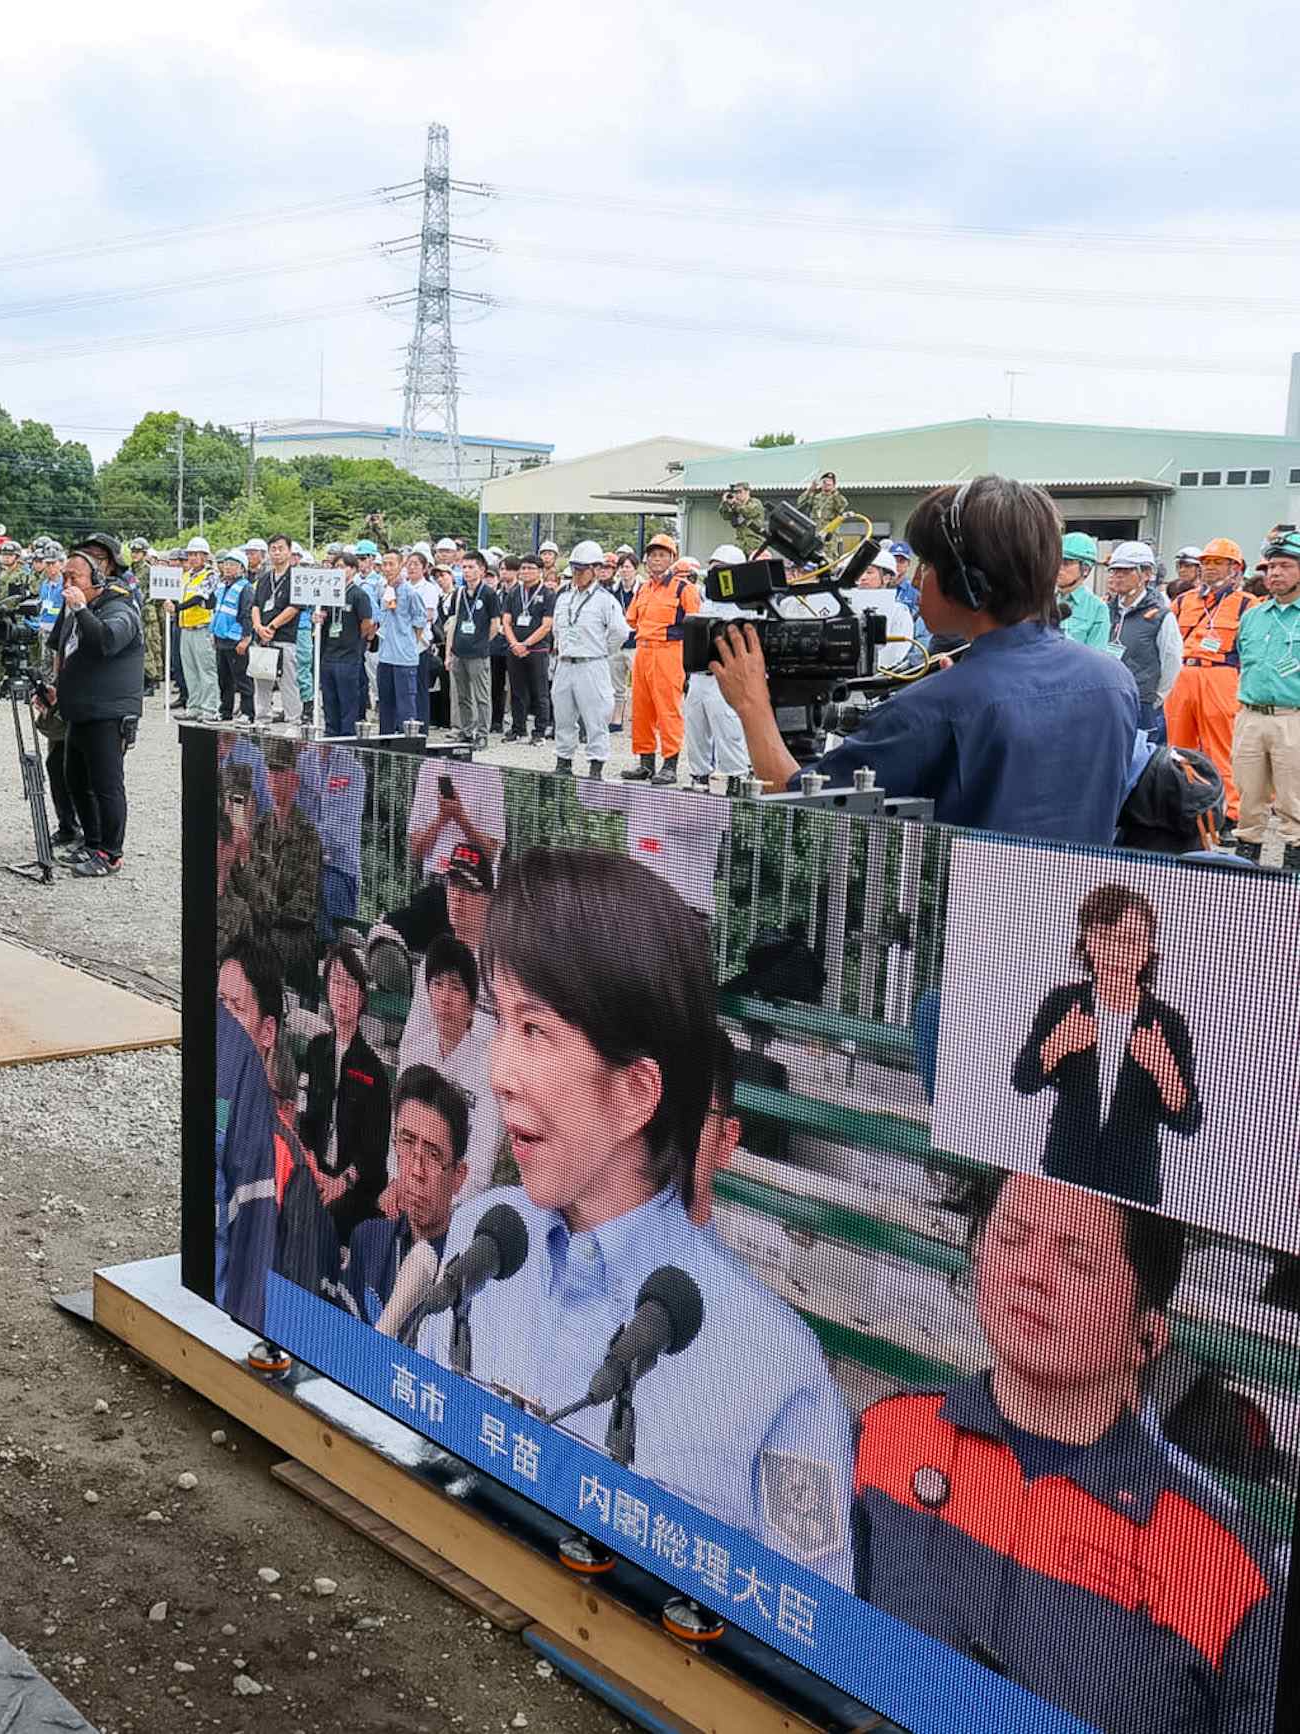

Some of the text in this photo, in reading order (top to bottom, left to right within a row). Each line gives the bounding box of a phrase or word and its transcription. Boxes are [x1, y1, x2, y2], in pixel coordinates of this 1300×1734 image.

[294, 575, 341, 586] ボランティア
[391, 1362, 818, 1649] 高市 早苗 内閣総理大臣
